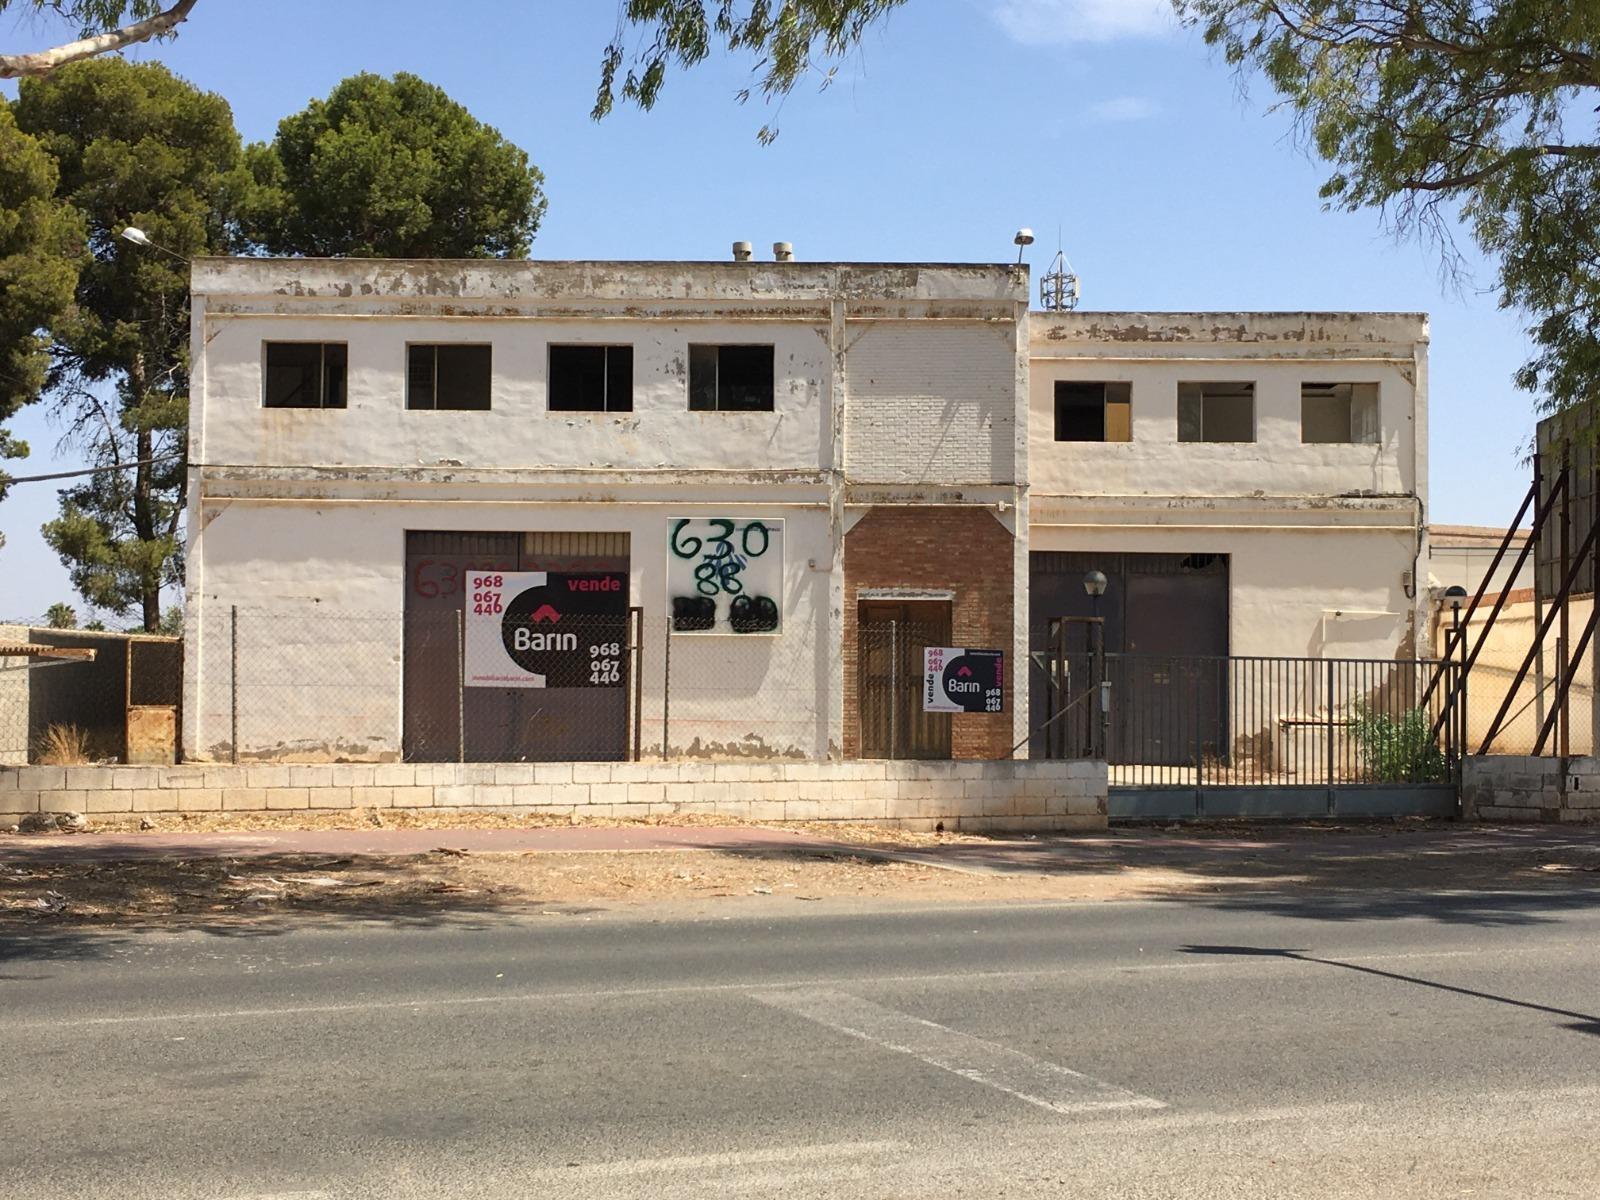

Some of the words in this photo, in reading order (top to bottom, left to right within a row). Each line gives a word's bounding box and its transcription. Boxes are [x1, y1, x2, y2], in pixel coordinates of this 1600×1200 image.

[671, 518, 769, 559] 630
[473, 575, 503, 589] 968
[567, 576, 621, 592] vende
[694, 562, 743, 595] 88
[473, 591, 502, 604] 067
[514, 627, 577, 651] Barin
[589, 642, 620, 659] 968
[928, 649, 944, 657] 968
[590, 658, 620, 673] 067
[926, 673, 935, 704] vende
[948, 678, 980, 693] Barin
[985, 688, 1001, 697] 968
